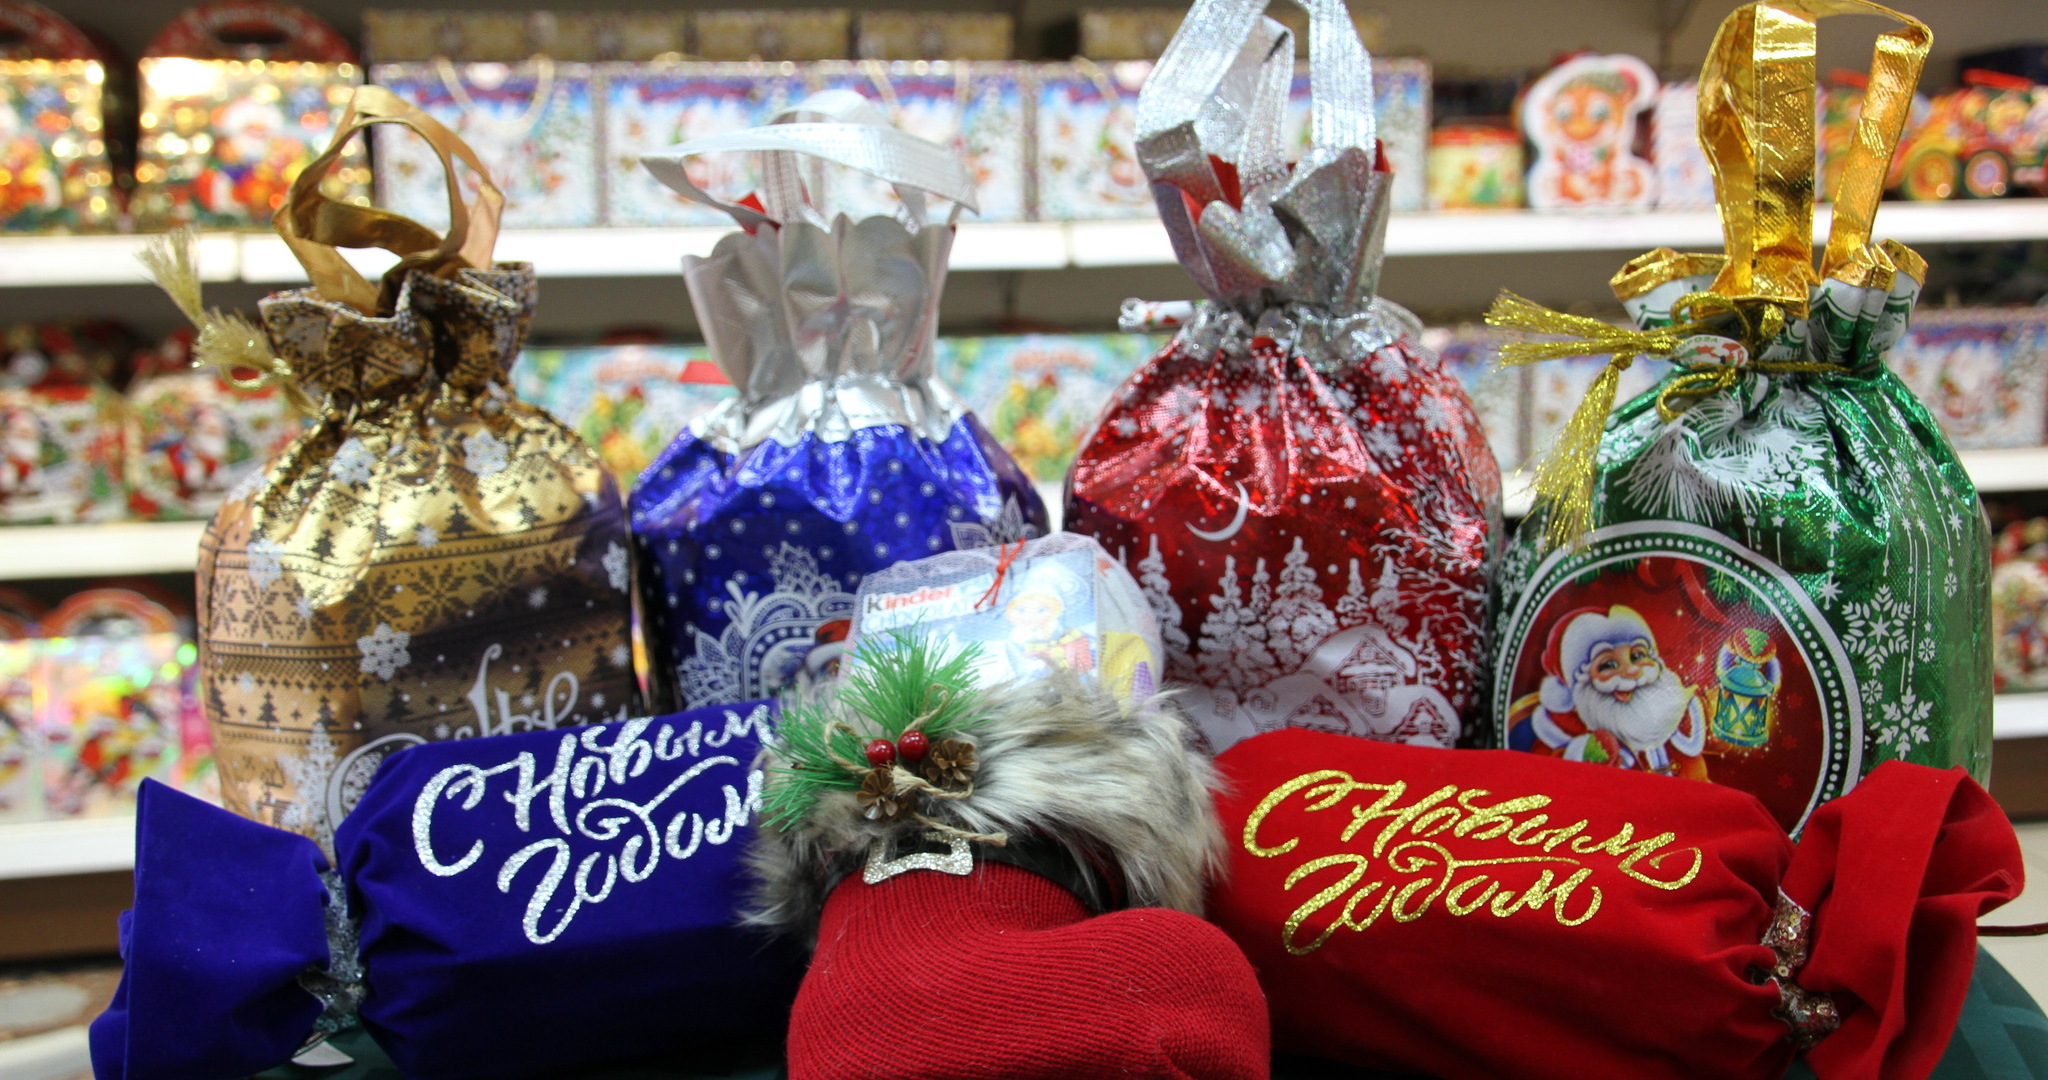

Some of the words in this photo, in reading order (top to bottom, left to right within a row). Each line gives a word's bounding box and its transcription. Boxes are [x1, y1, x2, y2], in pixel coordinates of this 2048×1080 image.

[411, 763, 486, 877] С
[1243, 769, 1355, 858] С
[1340, 781, 1702, 890] Новым
